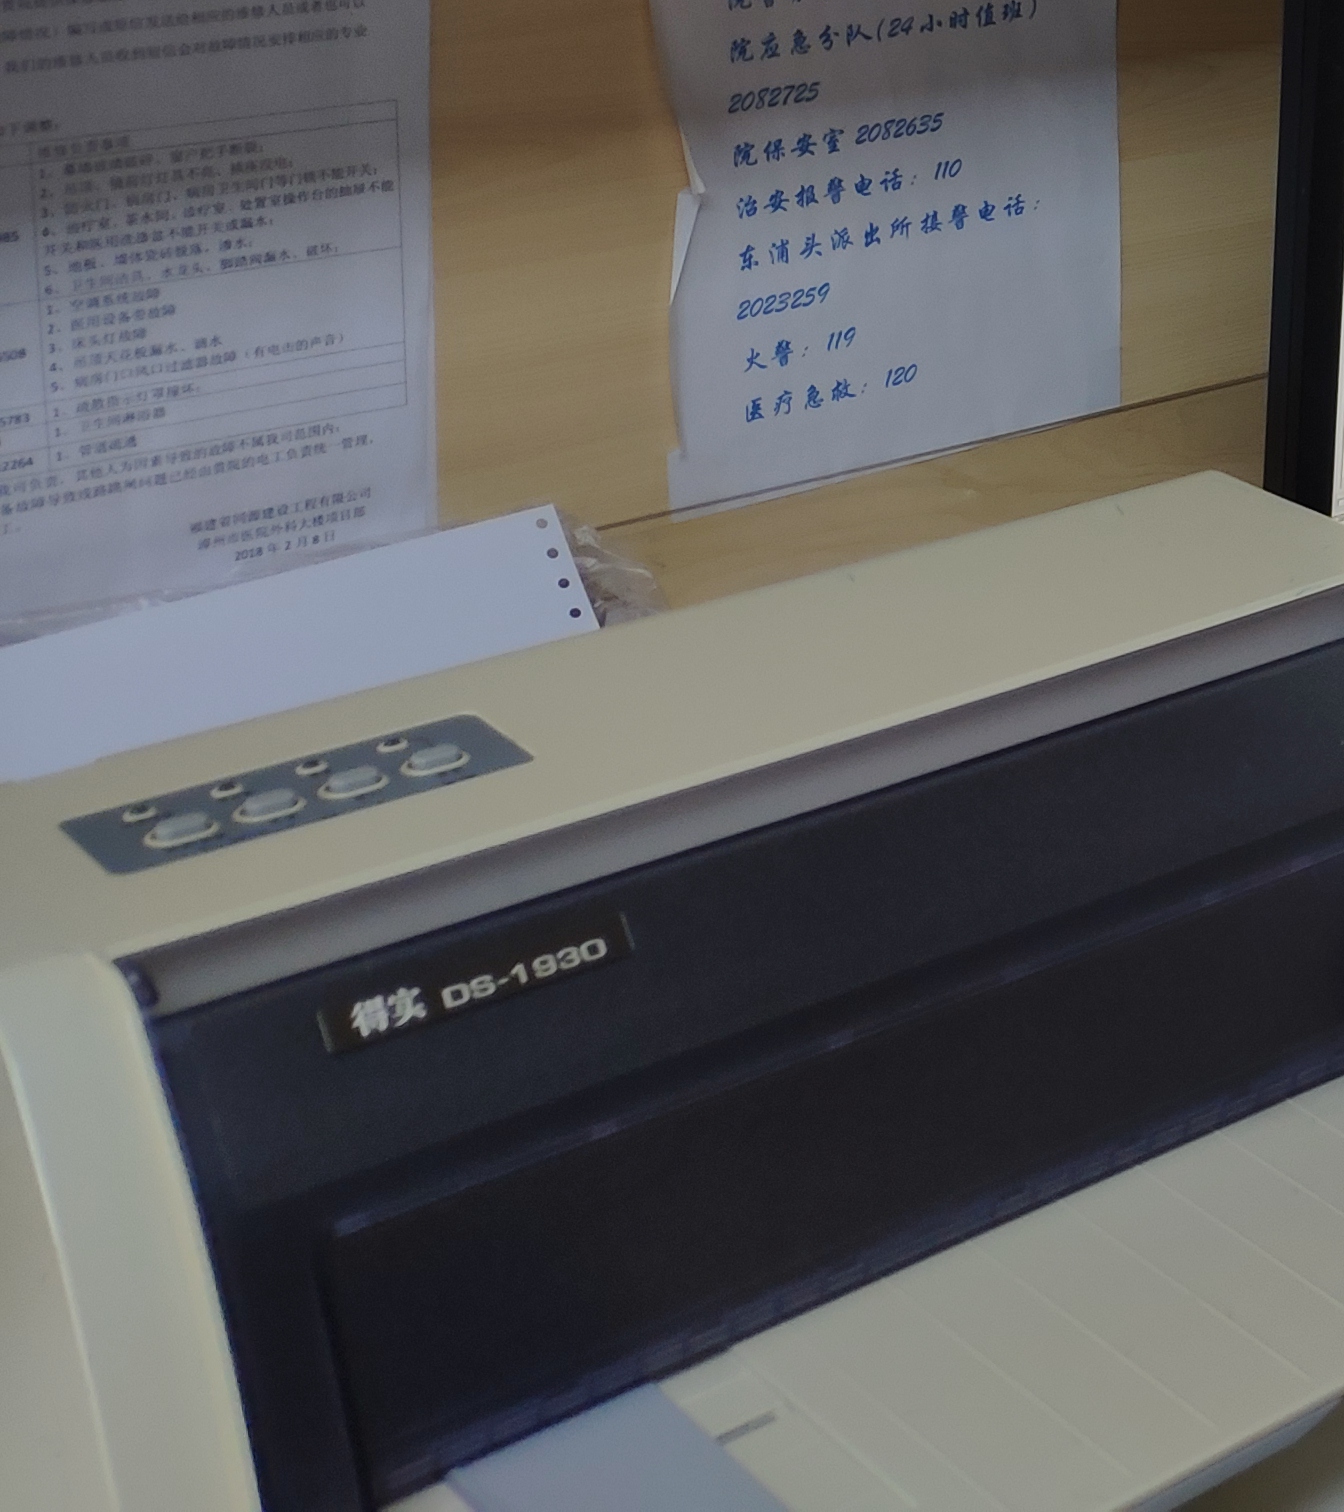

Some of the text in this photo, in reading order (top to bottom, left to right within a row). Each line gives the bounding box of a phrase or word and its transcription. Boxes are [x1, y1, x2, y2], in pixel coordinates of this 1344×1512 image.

[727, 82, 820, 114] 2082725
[733, 112, 944, 168] 院保安室 2082635
[934, 158, 963, 180] 110
[736, 282, 831, 321] 2023259
[827, 326, 857, 351] 119
[884, 363, 918, 388] 120
[350, 938, 609, 1038] 得实 DS-1930
